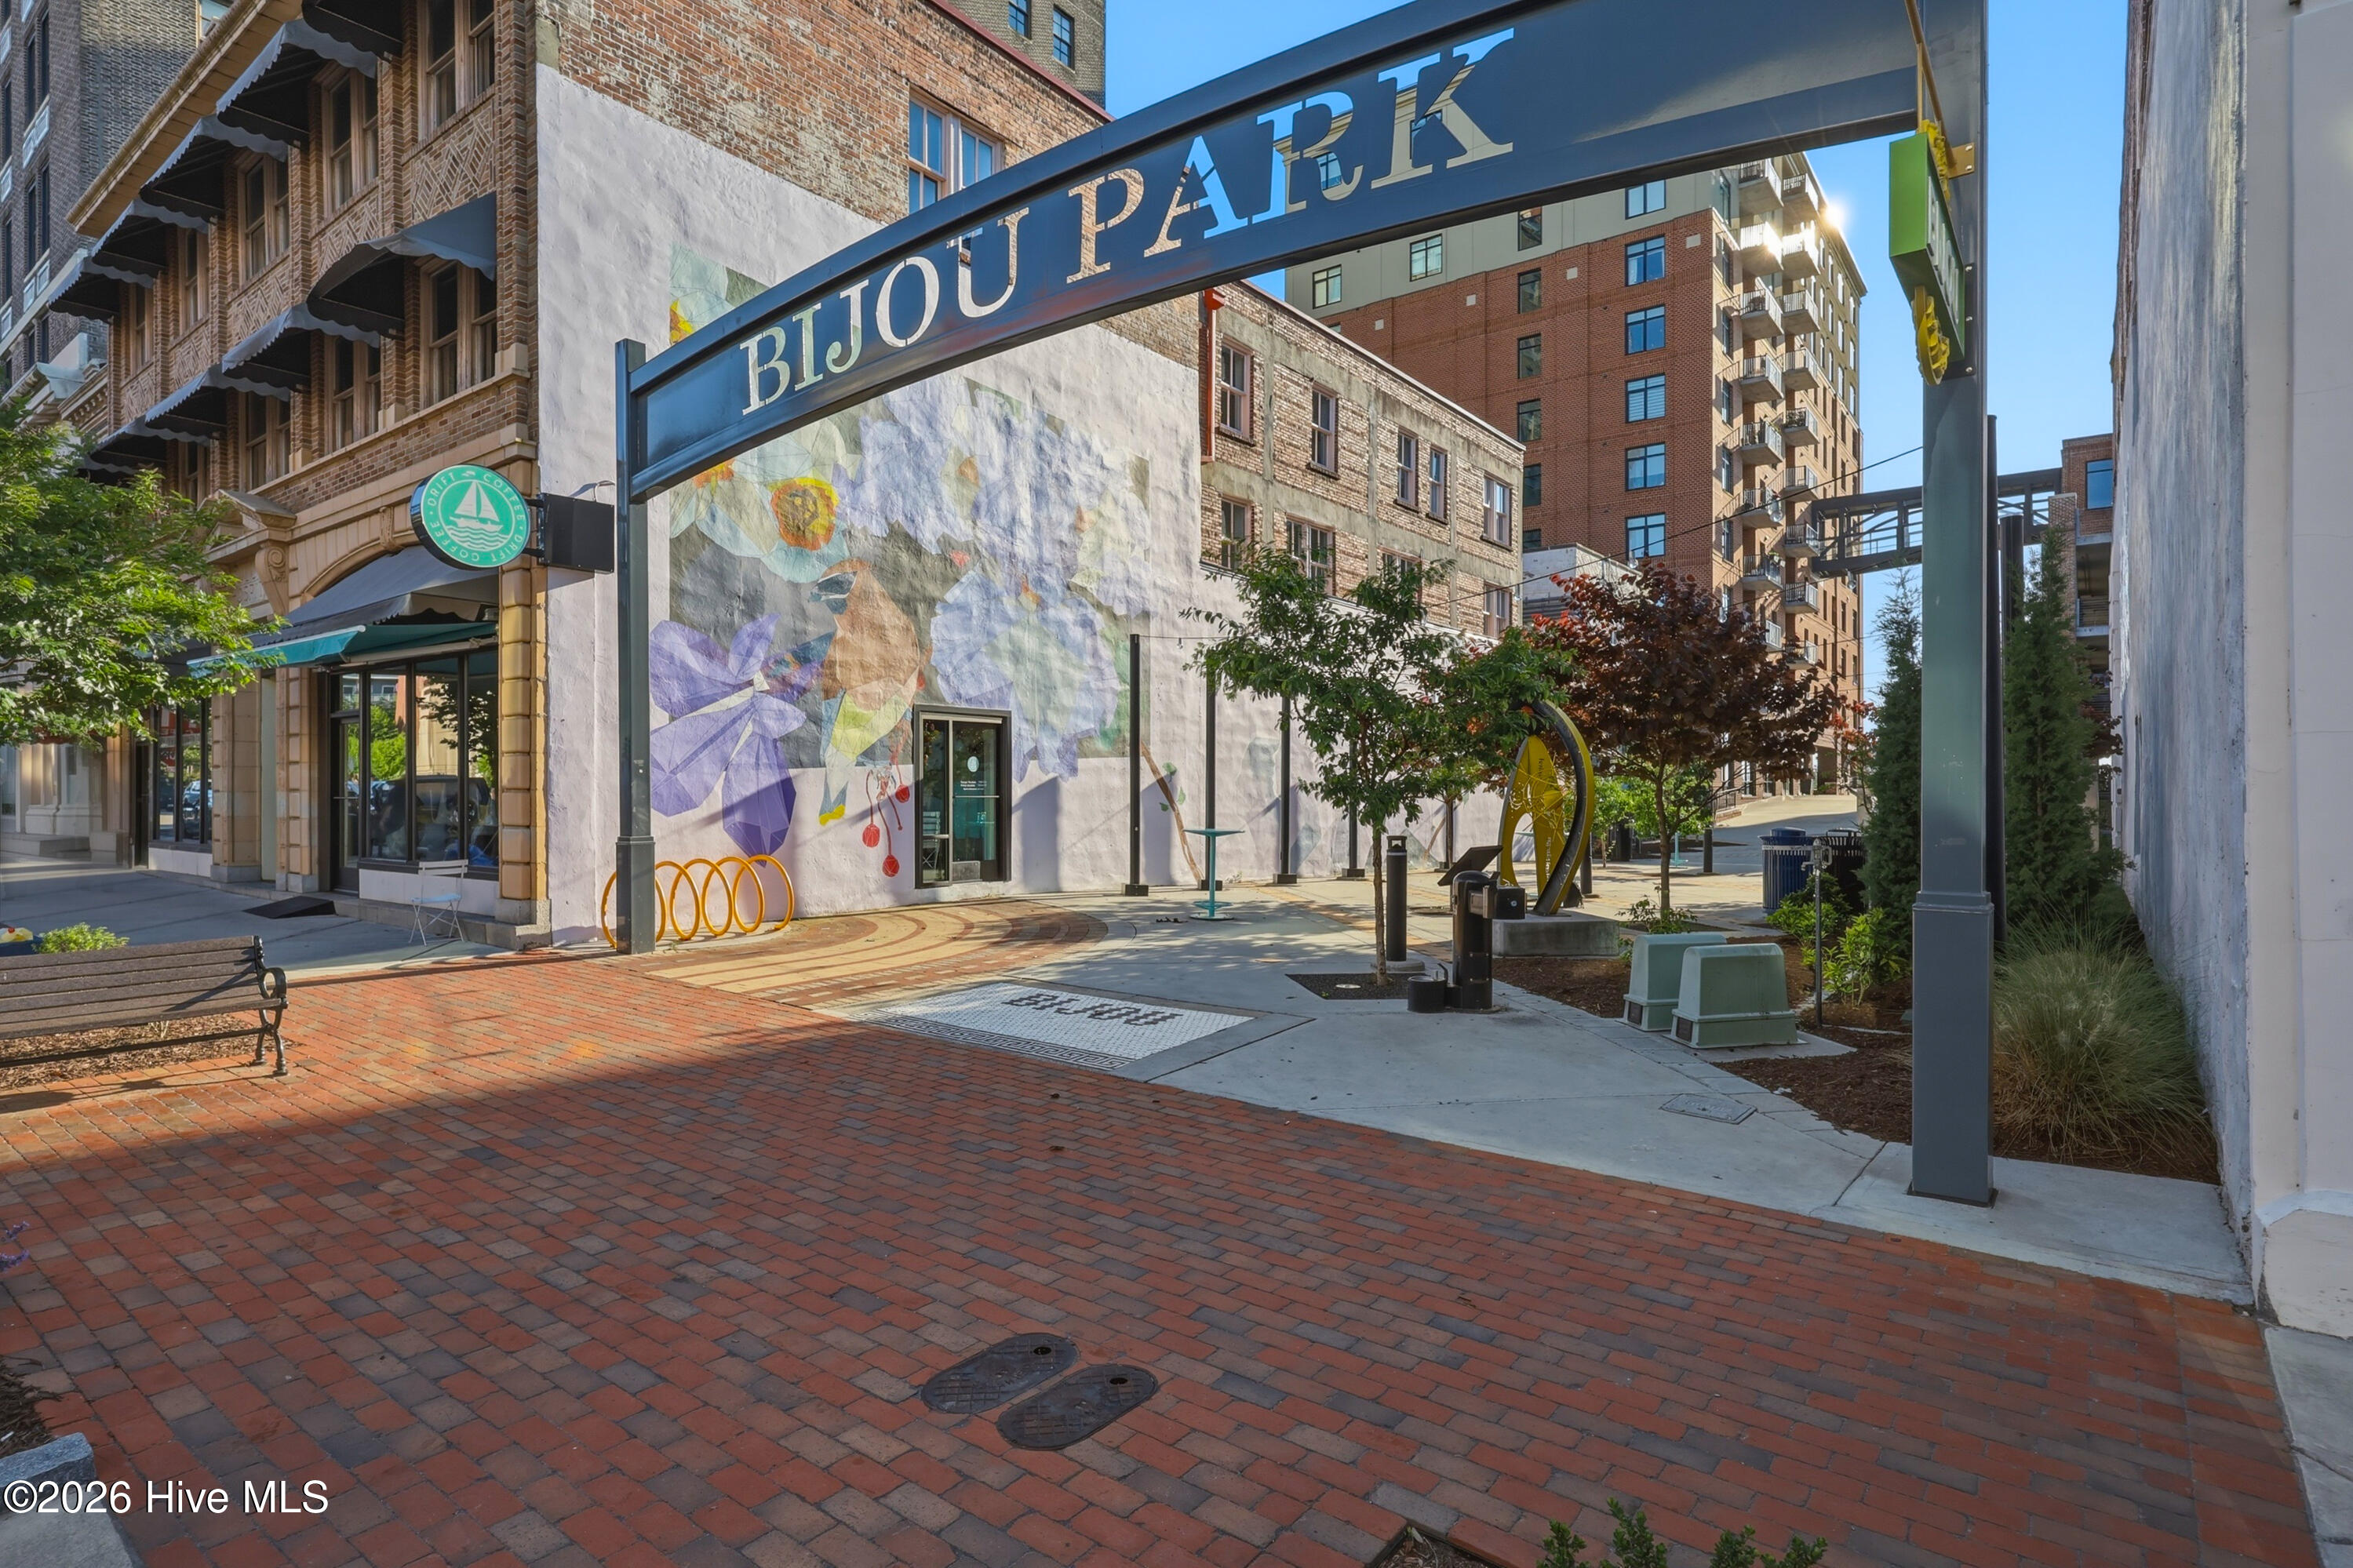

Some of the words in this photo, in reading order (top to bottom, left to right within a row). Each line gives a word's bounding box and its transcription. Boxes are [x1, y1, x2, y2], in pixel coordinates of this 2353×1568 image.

[740, 208, 1030, 415] BIJOU
[1065, 28, 1513, 284] PARK
[428, 472, 456, 506] DRIFT
[483, 473, 525, 521] COFFEE
[430, 521, 480, 562] COFFEE
[490, 534, 523, 562] DRIFT
[1001, 993, 1184, 1026] BIJOU
